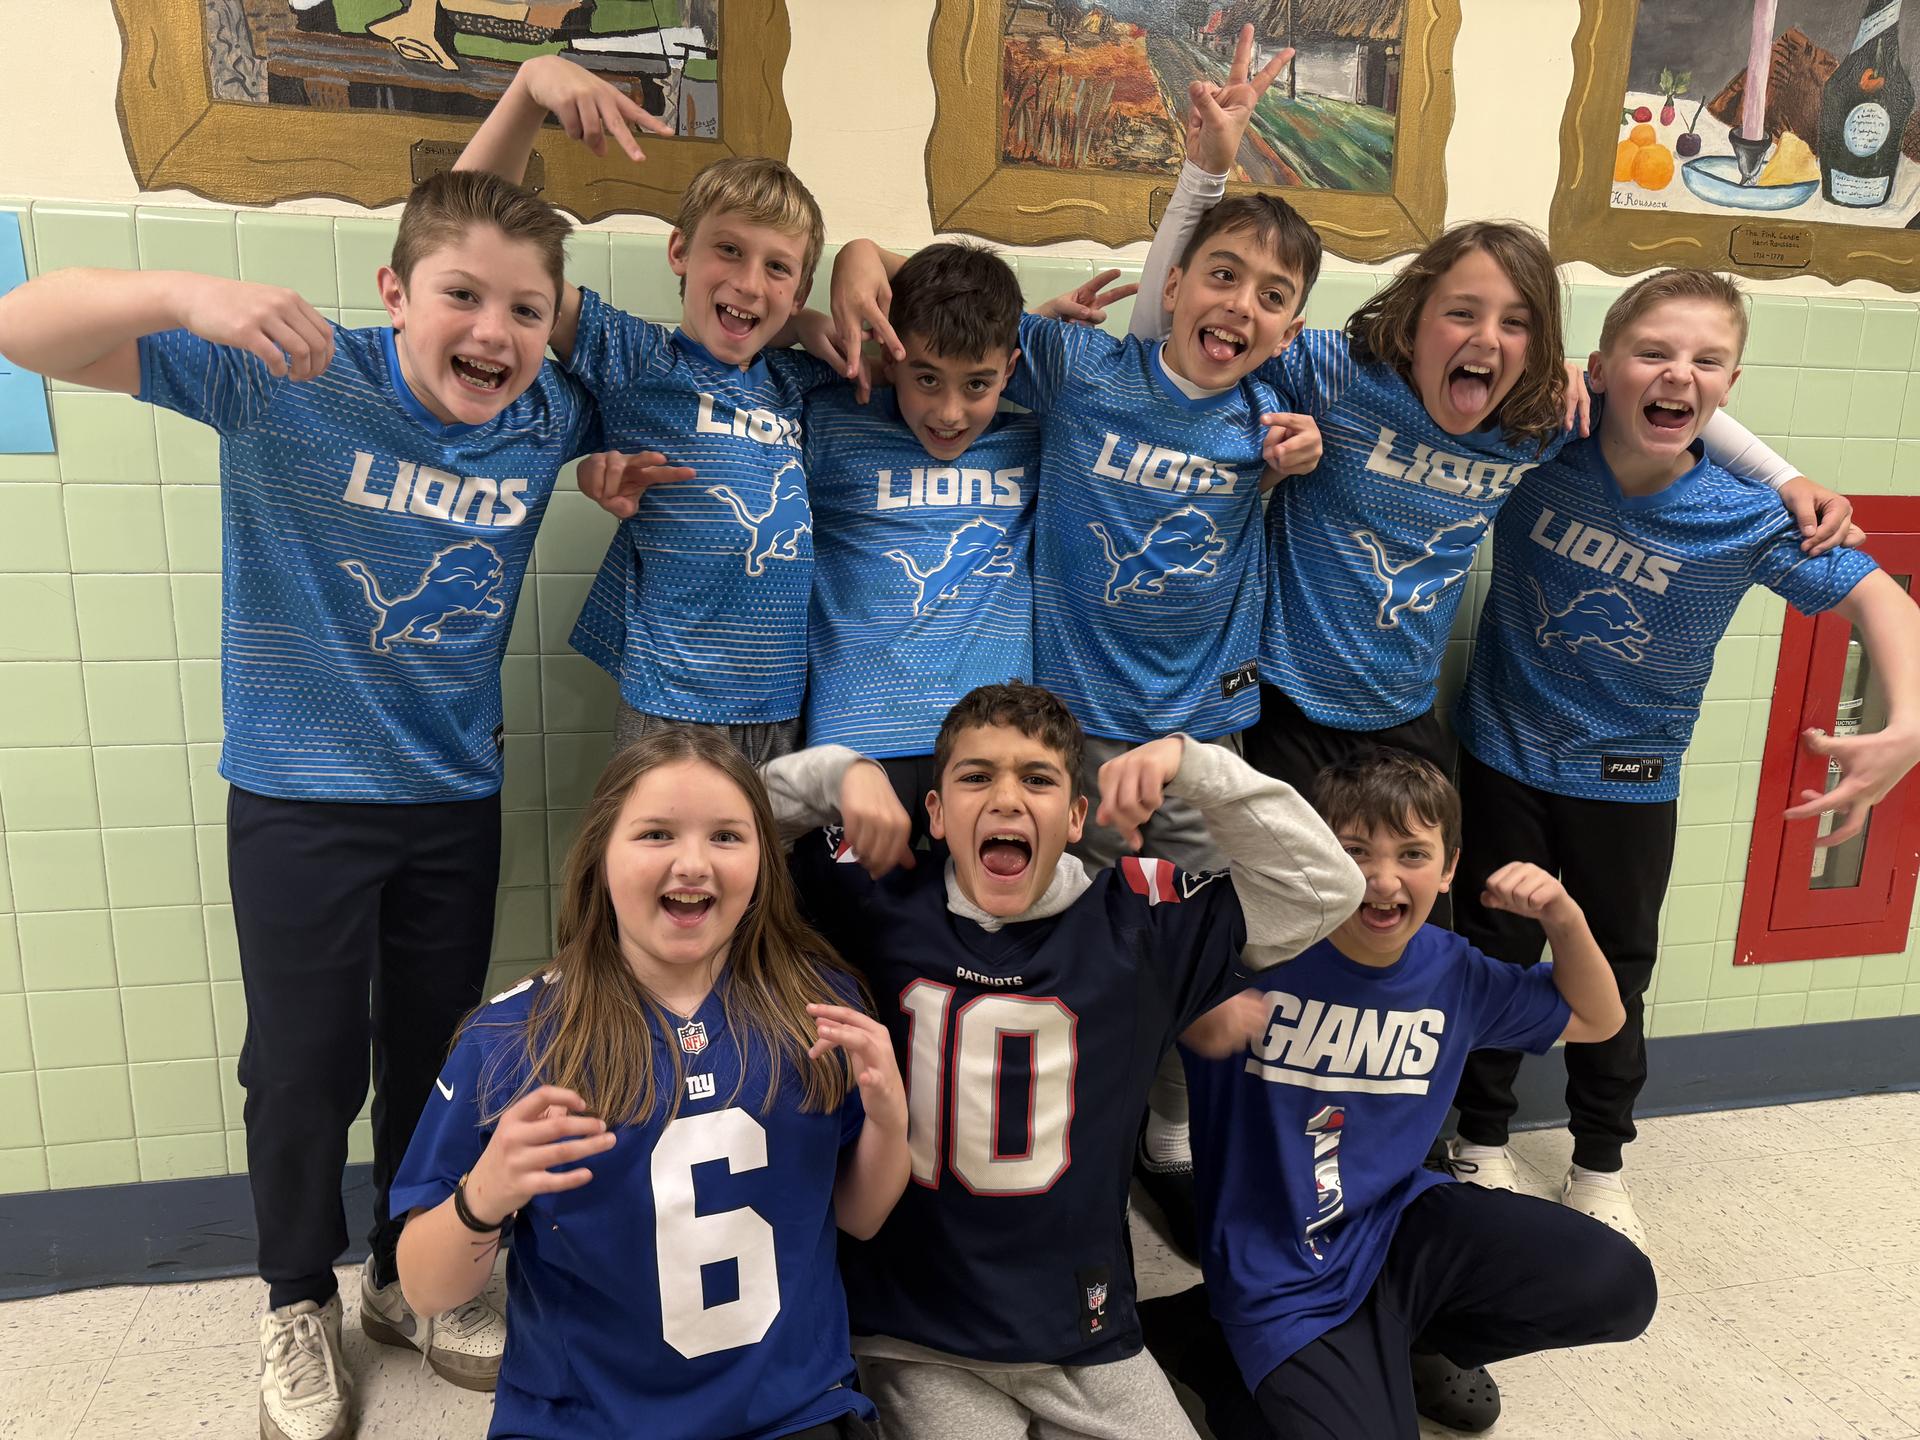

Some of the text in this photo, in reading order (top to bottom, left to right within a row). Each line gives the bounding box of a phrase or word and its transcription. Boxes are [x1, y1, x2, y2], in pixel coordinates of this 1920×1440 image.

[1624, 192, 1668, 208] Rousseau
[1093, 432, 1238, 494] LIONS
[343, 450, 529, 526] LIONS
[877, 467, 1024, 511] LIONS
[1529, 507, 1683, 595] LIONS
[1246, 671, 1256, 682] L
[1610, 763, 1640, 773] FLAG
[1647, 767, 1653, 778] L
[956, 966, 1023, 986] PATRIOTS
[684, 1034, 705, 1050] NFL
[1250, 990, 1446, 1077] GIANTS
[900, 977, 1079, 1197] 10
[650, 1106, 781, 1360] 6
[1091, 1294, 1105, 1307] NFL
